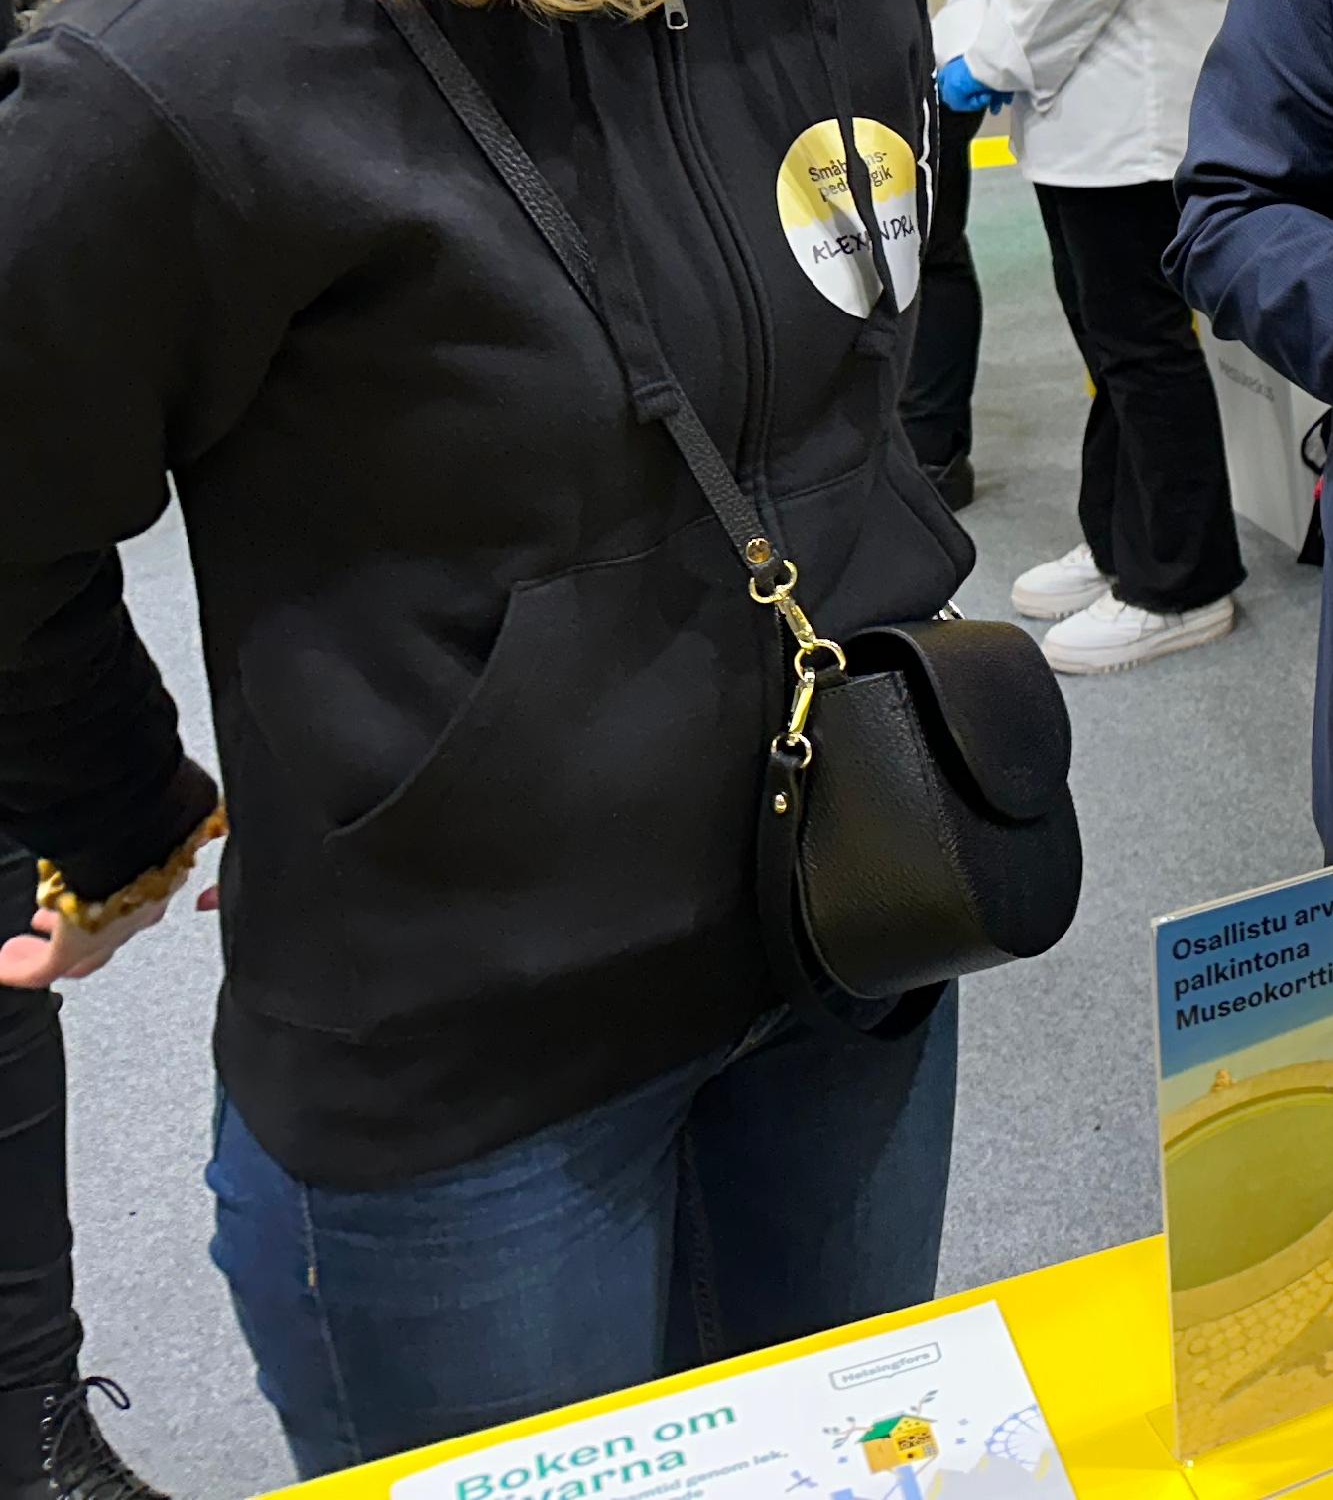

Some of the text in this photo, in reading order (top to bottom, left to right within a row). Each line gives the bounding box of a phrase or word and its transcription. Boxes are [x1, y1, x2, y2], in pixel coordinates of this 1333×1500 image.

[808, 151, 888, 183] Småbns-
[818, 164, 893, 203] pedgik
[812, 214, 916, 264] ALEXNDRA
[1172, 914, 1287, 960] Osallistu
[1174, 942, 1311, 1001] palkintona
[455, 1405, 737, 1500] Boken om
